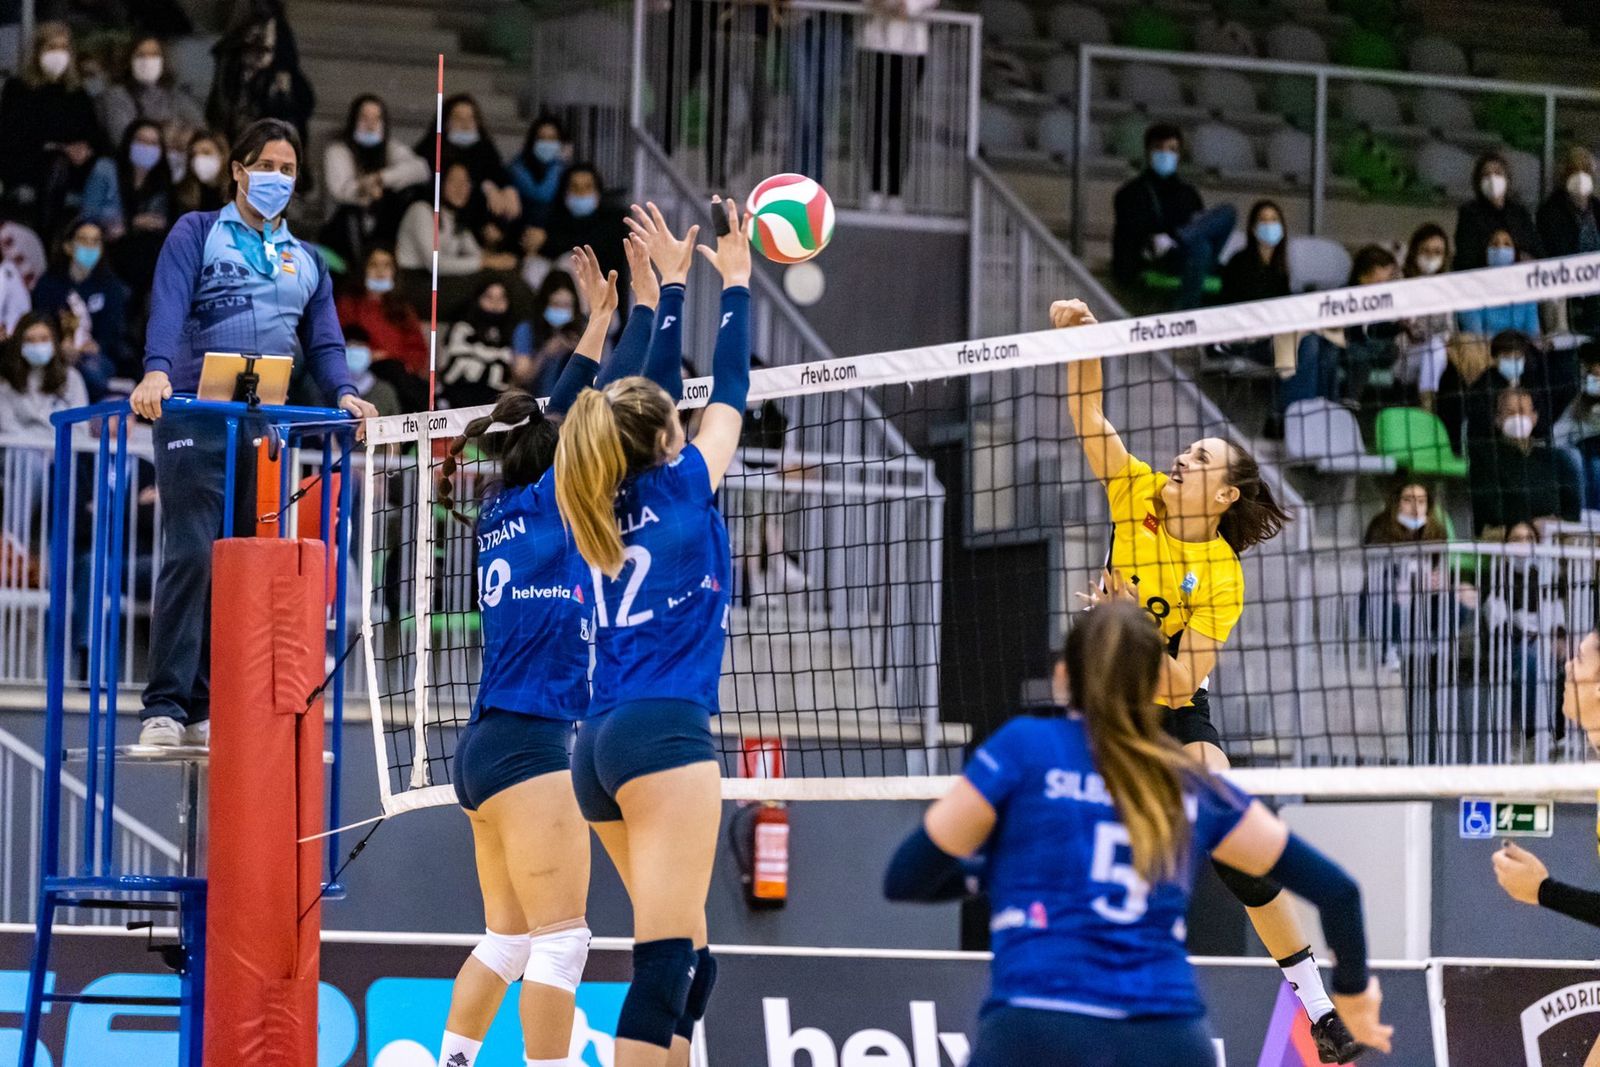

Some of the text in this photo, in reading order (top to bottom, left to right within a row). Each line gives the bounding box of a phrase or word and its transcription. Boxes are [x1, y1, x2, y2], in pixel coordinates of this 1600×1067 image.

[1318, 290, 1394, 317] rfevb.com
[1129, 314, 1197, 342] rfevb.com
[957, 342, 1019, 365] rfevb.com
[800, 363, 857, 386] rfevb.com
[511, 585, 571, 600] helvetia
[589, 544, 654, 628] 12
[1091, 821, 1150, 924] 5
